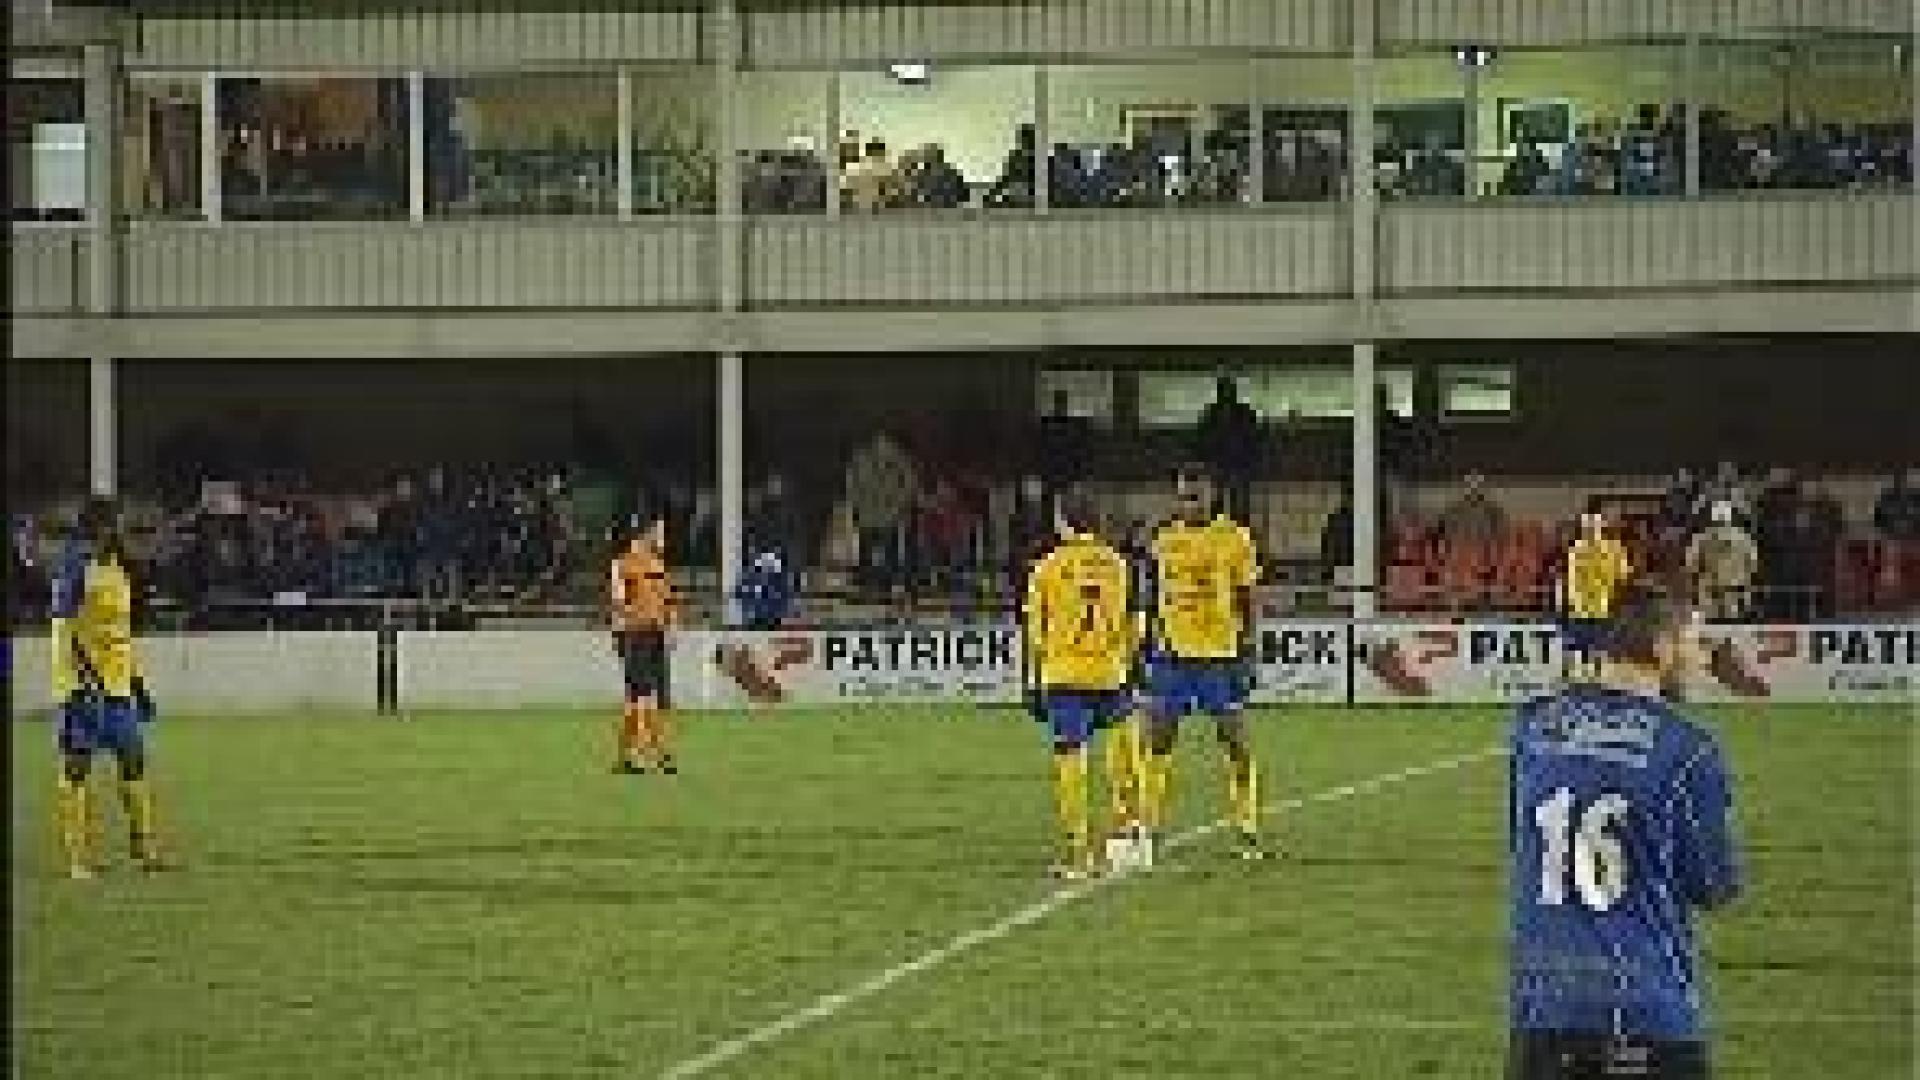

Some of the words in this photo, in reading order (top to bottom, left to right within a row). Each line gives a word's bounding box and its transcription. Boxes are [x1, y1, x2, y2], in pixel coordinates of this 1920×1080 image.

[823, 631, 1017, 670] PATRICK
[1259, 629, 1336, 665] ICK
[1469, 629, 1557, 666] PAT
[1535, 786, 1630, 911] 16
